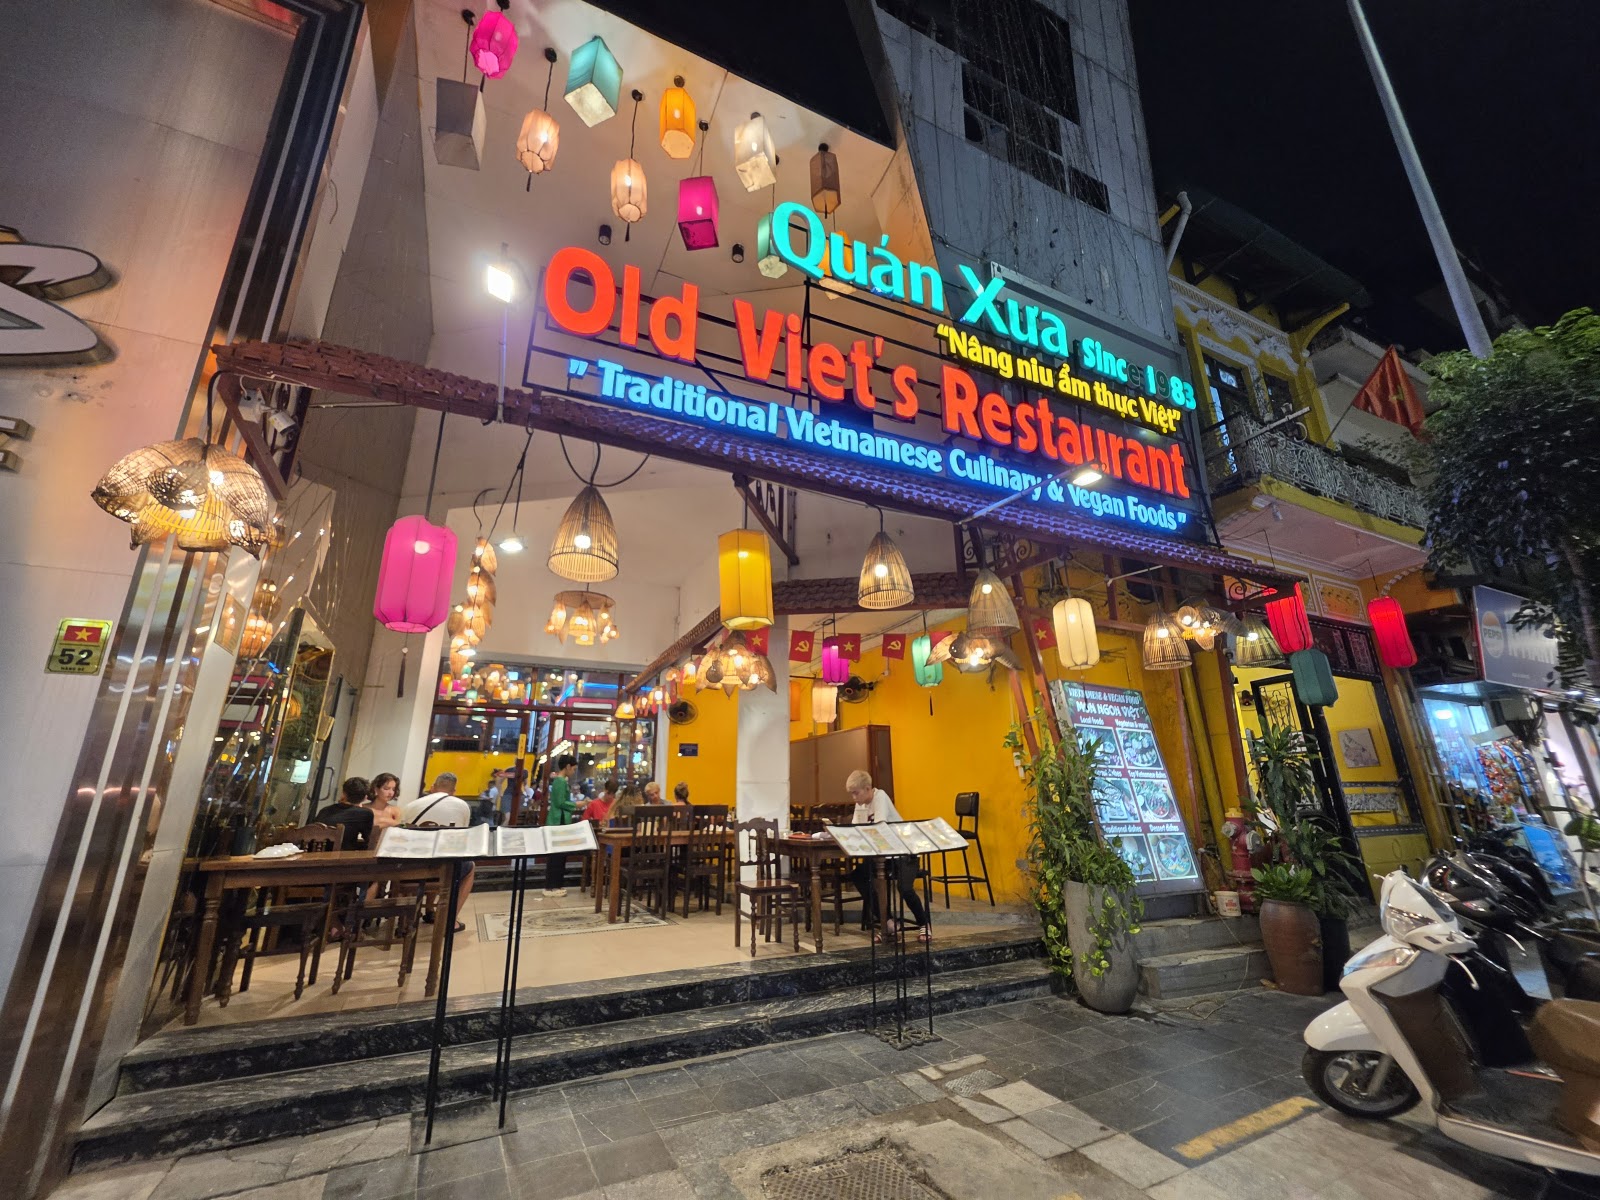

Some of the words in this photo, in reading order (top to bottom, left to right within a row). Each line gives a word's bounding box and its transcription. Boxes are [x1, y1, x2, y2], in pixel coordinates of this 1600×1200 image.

[771, 201, 944, 312] Quán
[956, 263, 1070, 357] Xưa
[1145, 365, 1197, 412] 1983
[544, 246, 699, 365] Old
[733, 298, 919, 419] Viet's
[941, 365, 1190, 499] Restaurant
[1017, 356, 1054, 388] niu
[1056, 363, 1091, 402] ẩm
[1093, 382, 1138, 419] thực
[784, 406, 943, 473] Vietnamese
[949, 448, 1042, 502] Culinary
[1047, 473, 1064, 503] &
[58, 648, 93, 666] 52
[1097, 704, 1121, 717] NGON
